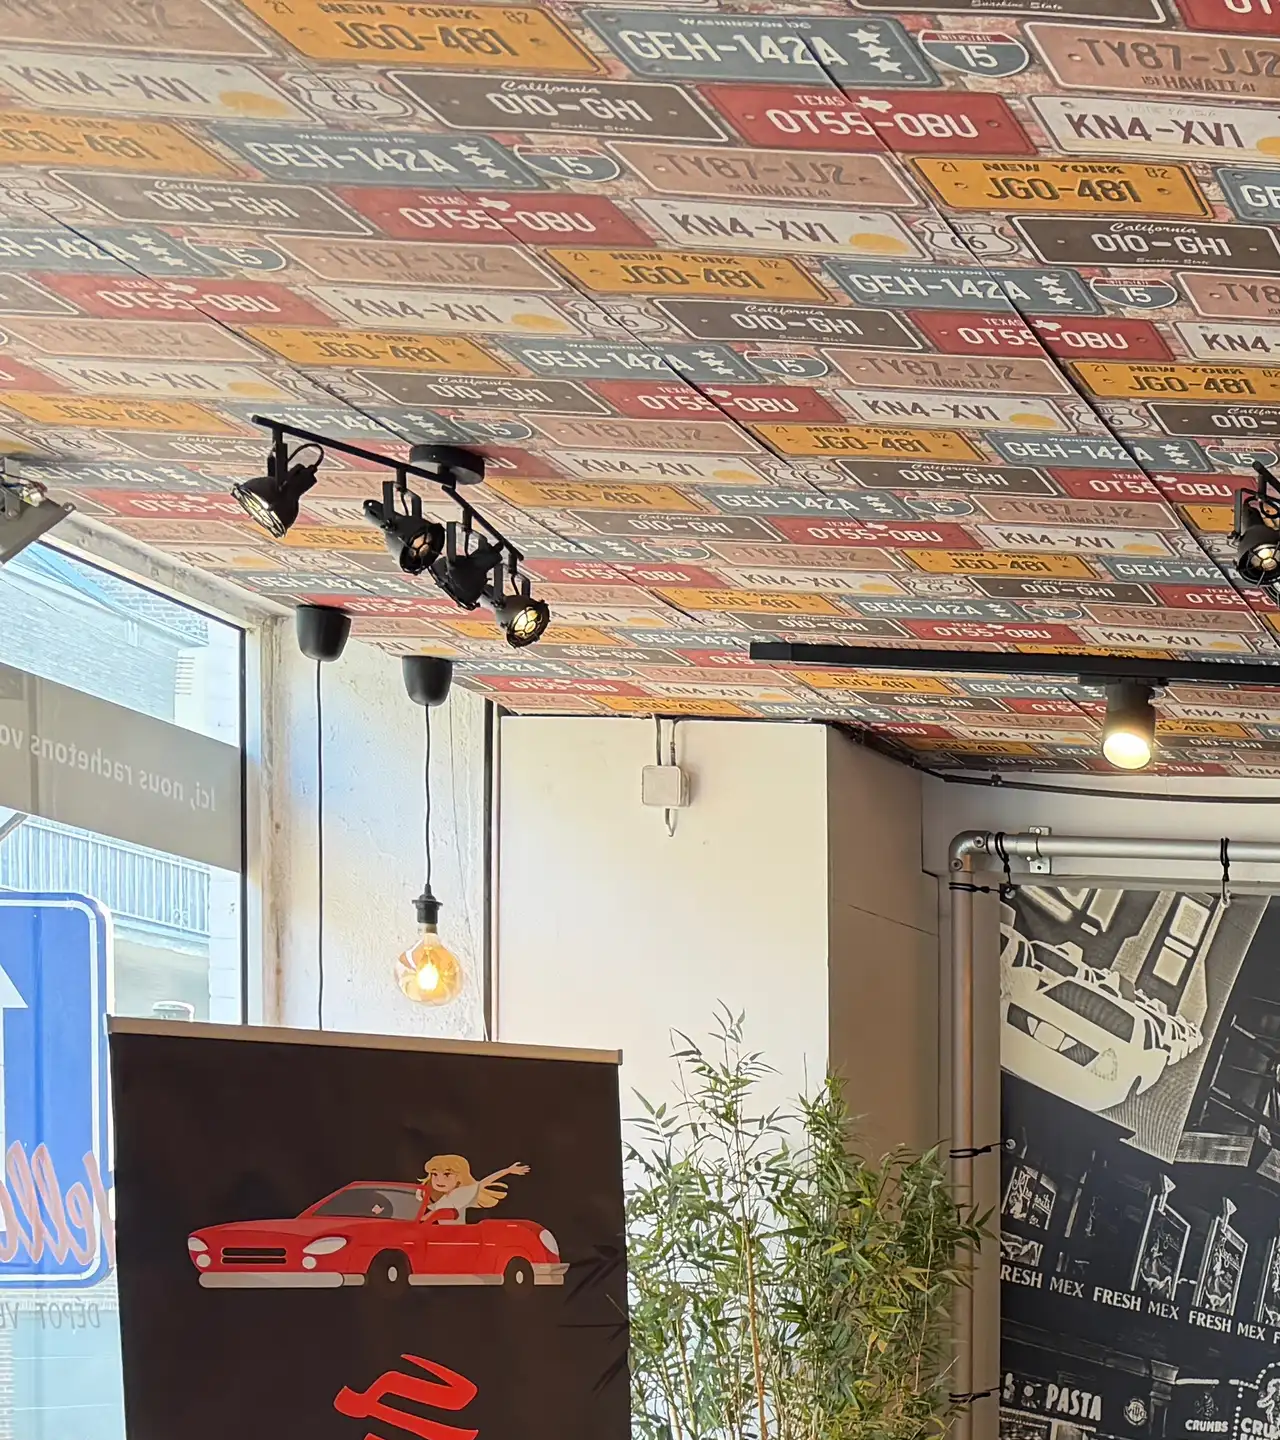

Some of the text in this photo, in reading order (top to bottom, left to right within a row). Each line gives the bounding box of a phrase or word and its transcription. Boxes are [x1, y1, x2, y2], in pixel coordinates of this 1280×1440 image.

[319, 3, 483, 23] NEW YORK
[678, 16, 788, 30] WASHINGTON
[619, 26, 846, 66] GEH-142A
[956, 45, 998, 67] 15
[501, 79, 600, 95] California
[244, 140, 457, 174] GEH-142A
[550, 156, 593, 175] 15
[849, 272, 1029, 300] GEH-142A
[1049, 1275, 1085, 1299] MEX
[1092, 1286, 1141, 1312] FRESH
[1147, 1299, 1180, 1321] MEX
[1188, 1310, 1232, 1334] FRESH
[1236, 1322, 1266, 1342] MEX
[1045, 1382, 1103, 1422] PASTA
[1184, 1418, 1229, 1434] CRUMBS
